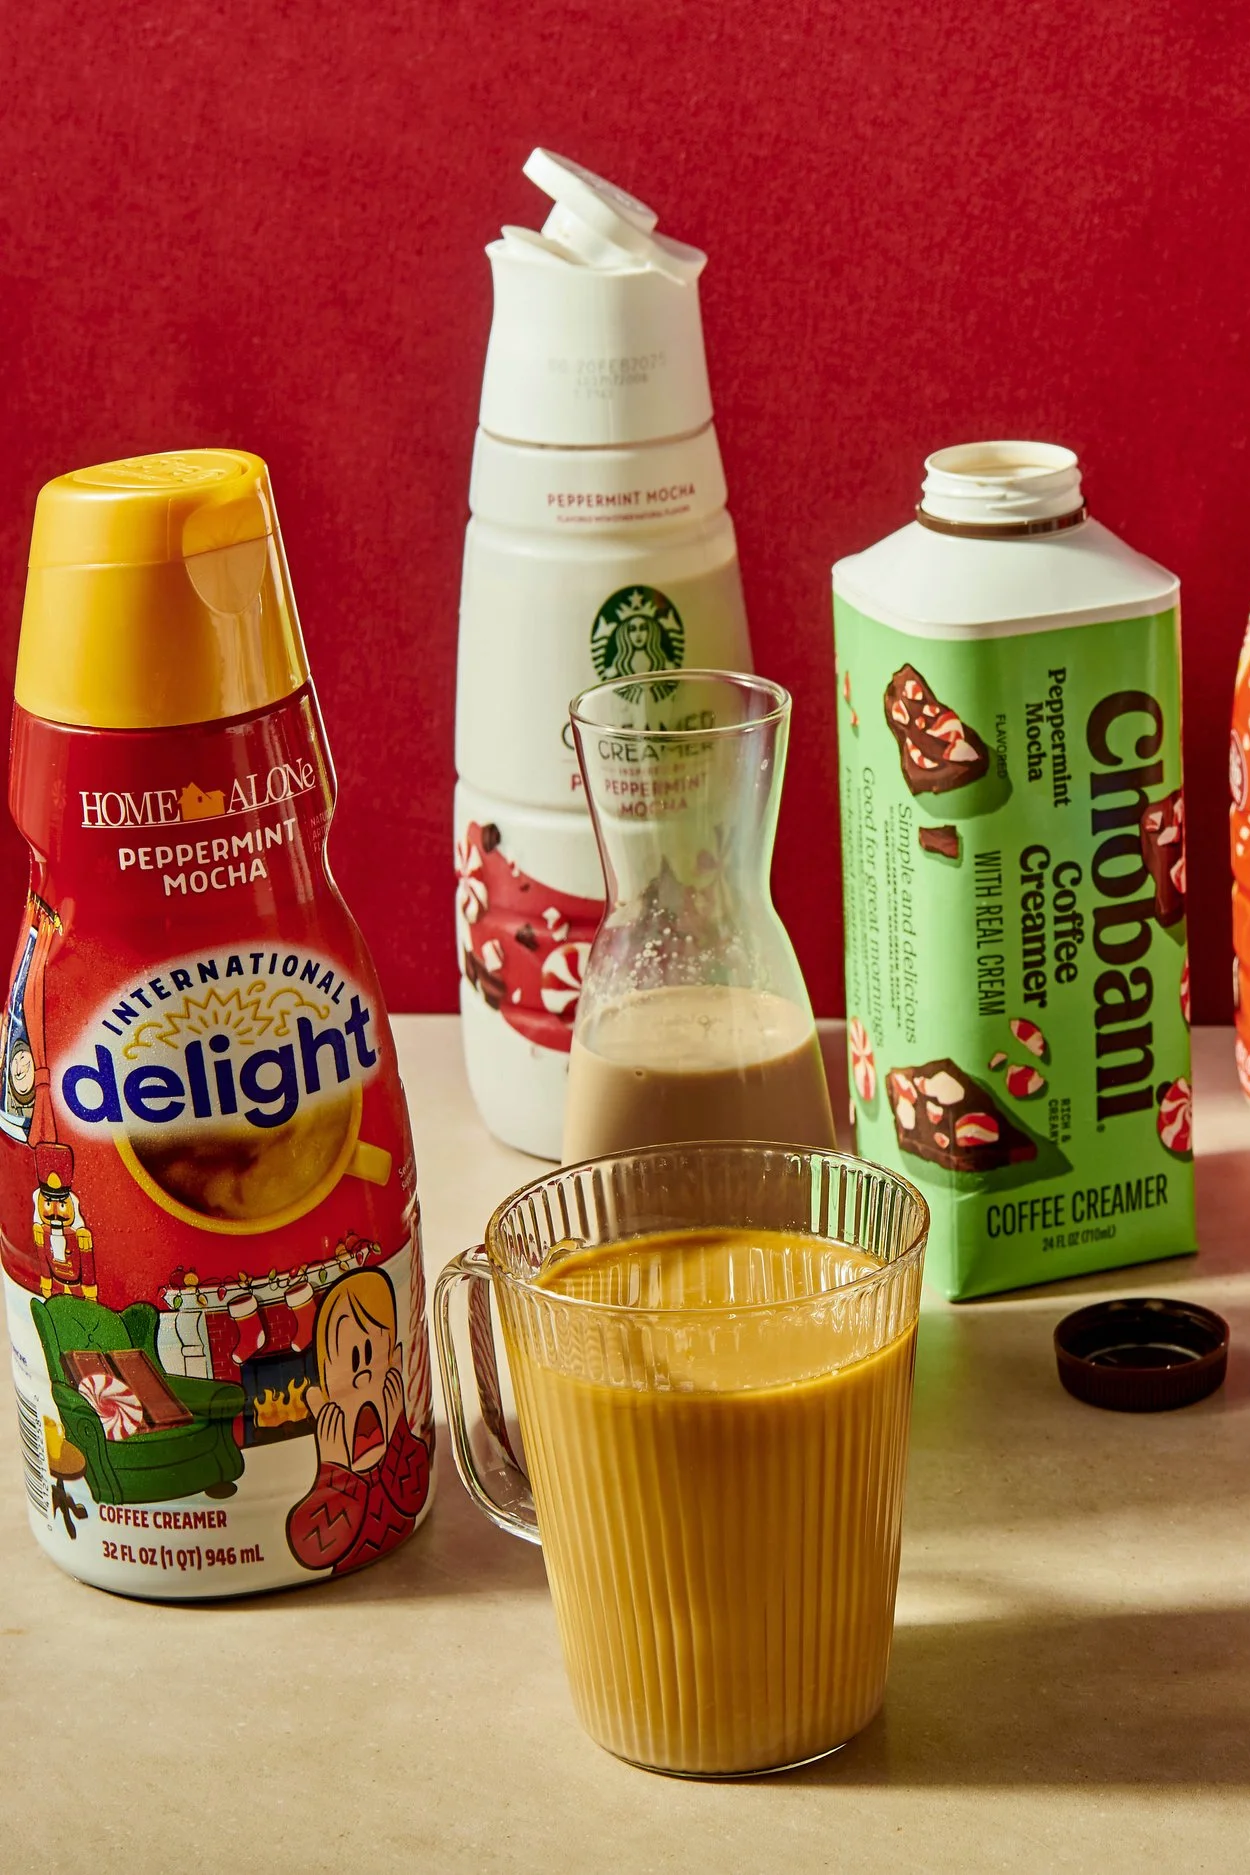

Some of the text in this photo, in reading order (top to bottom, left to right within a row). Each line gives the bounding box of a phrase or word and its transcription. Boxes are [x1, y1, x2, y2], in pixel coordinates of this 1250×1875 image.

[547, 483, 696, 509] PEPPERMINT MOCHA
[995, 713, 1008, 781] FLAVORED
[1025, 702, 1048, 783] Mocha
[1045, 667, 1072, 808] Peppermint
[80, 788, 182, 827] HOME
[604, 773, 707, 798] PEPPERMINT
[619, 799, 688, 819] MOCHA
[862, 767, 877, 832] Good
[118, 817, 297, 871] PEPPERMINT
[865, 836, 878, 870] for
[163, 858, 268, 897] MOCHA
[865, 872, 880, 933] great
[1086, 690, 1168, 1124] Chobani
[897, 803, 919, 1044] Simple and delicious
[974, 850, 1007, 1017] WITH REAL CREAM
[1019, 844, 1051, 1009] Creamer
[1052, 860, 1085, 984] Coffee
[102, 952, 347, 1036] INTERNATIONAL
[870, 938, 884, 1049] mornings
[62, 994, 379, 1128] delight
[1060, 1098, 1072, 1130] RICH
[986, 1173, 1168, 1239] COFFEE CREAMER
[1042, 1236, 1054, 1252] 24
[1056, 1235, 1066, 1248] FL
[1068, 1231, 1080, 1247] OZ
[99, 1504, 228, 1530] COFFEE CREAMER
[102, 1540, 265, 1571] 32 FL OZ (1 QT) 946 mL
